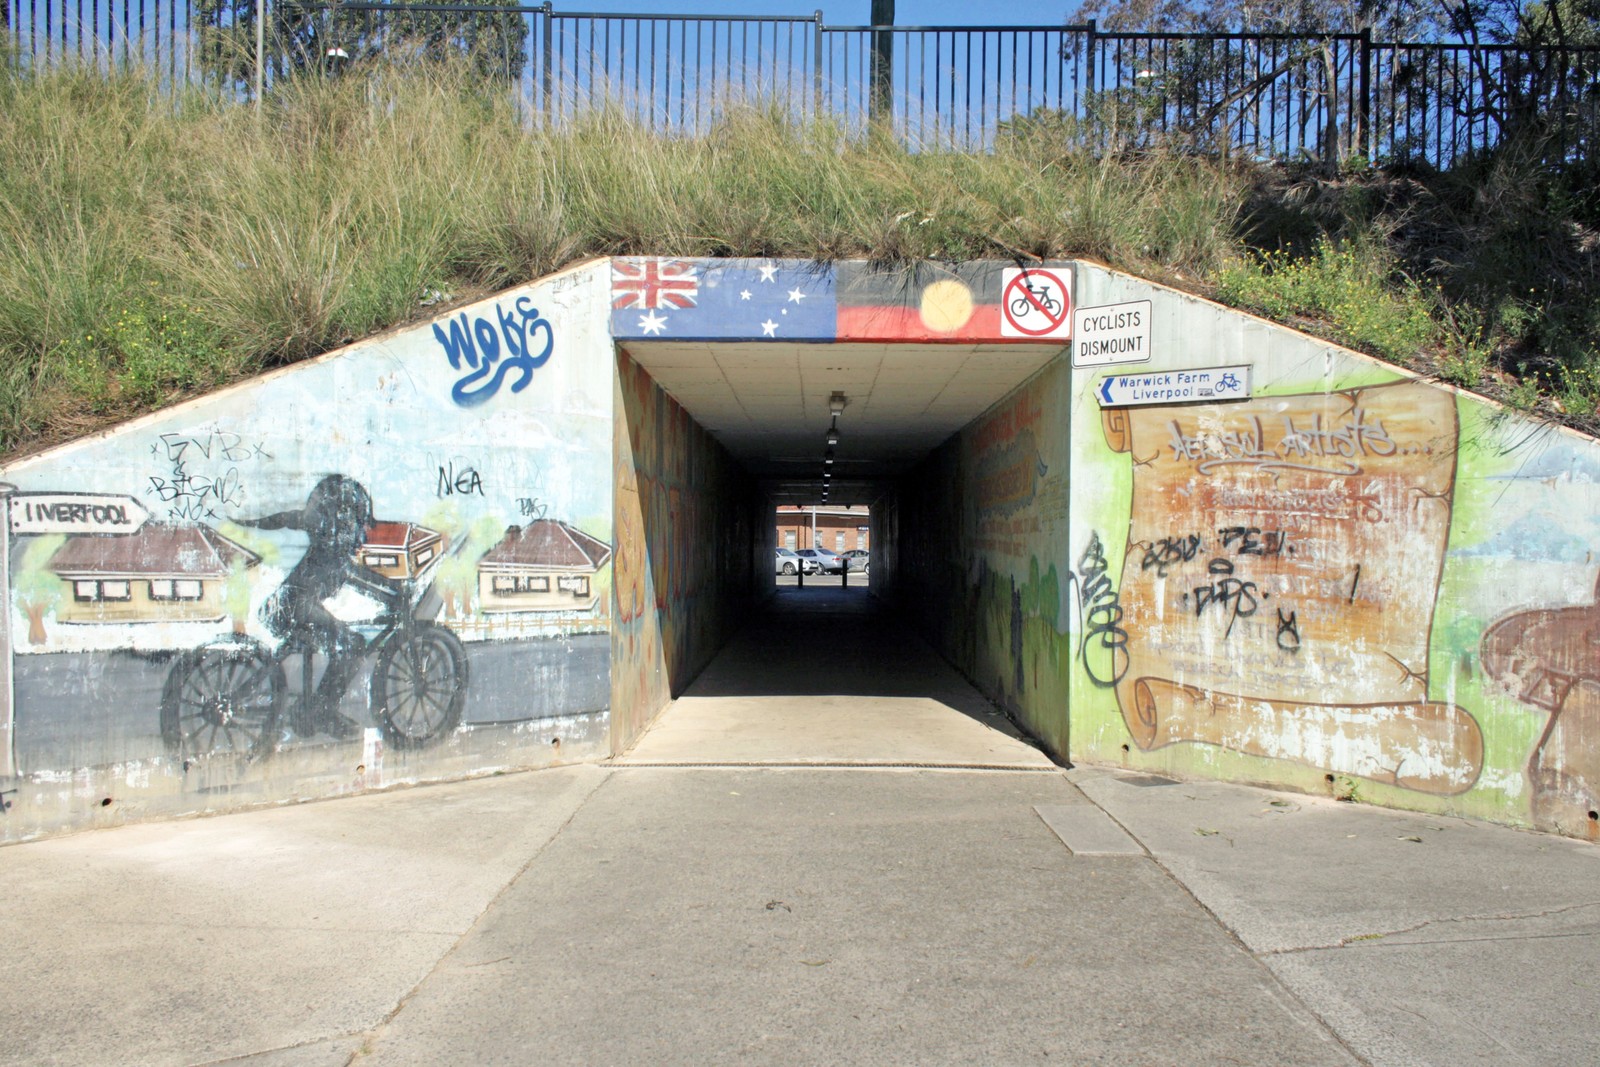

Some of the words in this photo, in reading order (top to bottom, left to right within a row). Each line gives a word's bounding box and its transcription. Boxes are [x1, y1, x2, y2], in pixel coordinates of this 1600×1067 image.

[1083, 311, 1141, 332] CYCLISTS
[1080, 336, 1143, 357] DISMOUNT
[1119, 375, 1171, 388] Warwick
[1177, 373, 1211, 386] Farm
[1133, 387, 1194, 400] Liverpool
